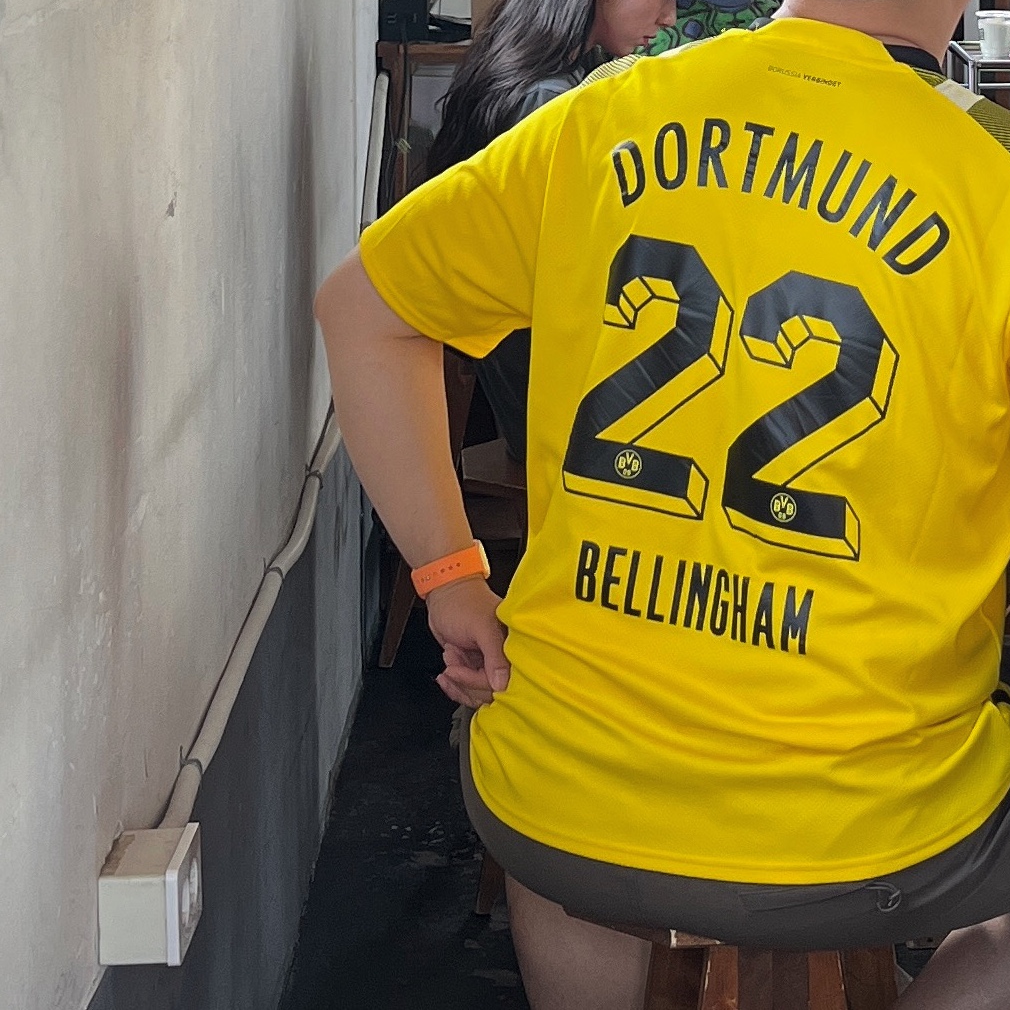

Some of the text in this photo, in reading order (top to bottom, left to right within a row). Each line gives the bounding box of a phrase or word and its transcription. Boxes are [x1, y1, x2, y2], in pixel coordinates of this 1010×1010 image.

[611, 117, 951, 276] DORTMUND
[562, 232, 900, 563] 22
[618, 451, 640, 471] BVB
[773, 495, 794, 516] BVB
[574, 539, 815, 656] BELLINGHAM
